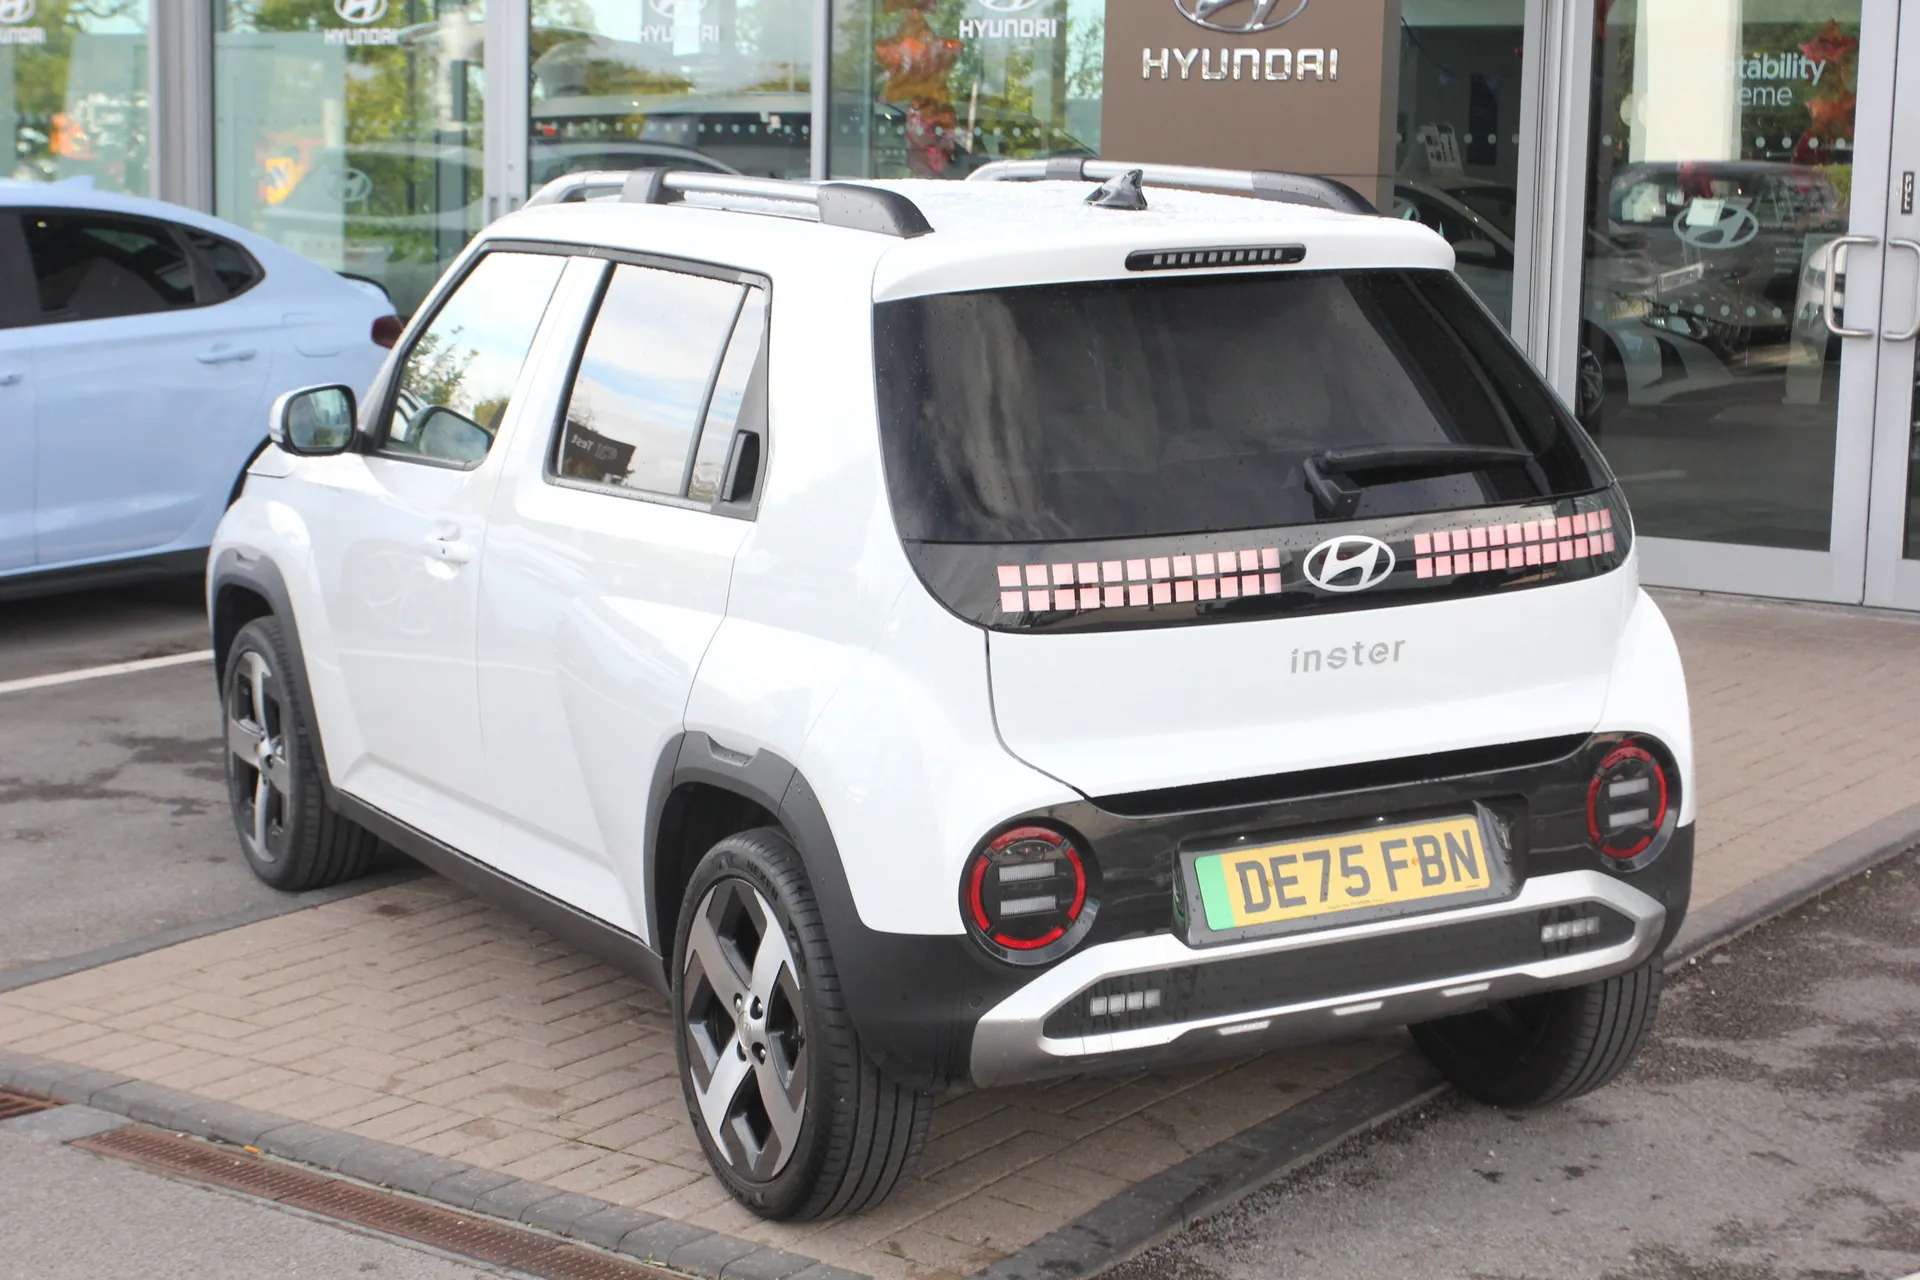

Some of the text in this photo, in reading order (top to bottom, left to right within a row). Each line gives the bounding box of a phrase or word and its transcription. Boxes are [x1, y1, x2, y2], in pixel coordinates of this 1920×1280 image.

[959, 18, 1057, 39] HYUNDAI
[1142, 47, 1338, 81] HYUNDAI
[1290, 639, 1406, 674] inster
[1235, 829, 1481, 914] DE75 FBN
